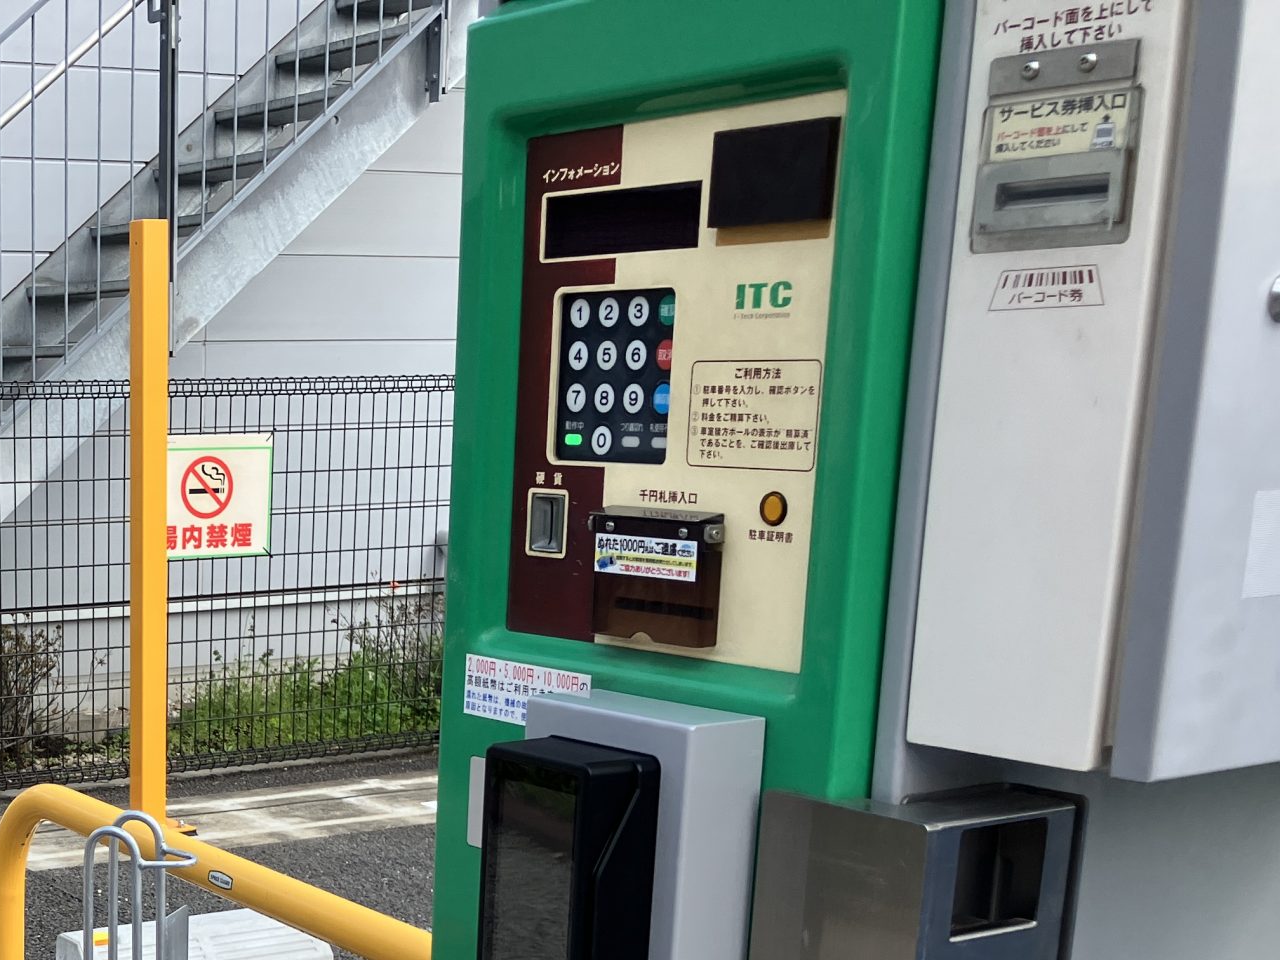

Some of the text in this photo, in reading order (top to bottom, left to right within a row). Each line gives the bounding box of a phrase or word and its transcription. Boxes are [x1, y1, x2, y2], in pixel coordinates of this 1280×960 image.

[993, 0, 1153, 35] バーコード面を上にして
[1019, 22, 1123, 53] 挿入して下さい
[999, 93, 1128, 123] サービス券挿入口
[542, 160, 621, 184] インフォメーション
[735, 280, 793, 310] ITC
[1007, 288, 1084, 305] バーコード券
[576, 303, 643, 321] 1 2 3
[573, 347, 640, 363] 4 5 6
[734, 367, 782, 380] ご利用方法
[571, 390, 581, 406] 7
[600, 390, 609, 406] 8
[629, 390, 638, 406] 9
[597, 432, 606, 448] 0
[638, 488, 698, 505] 千円札挿入口
[748, 528, 793, 544] 駐車証明書
